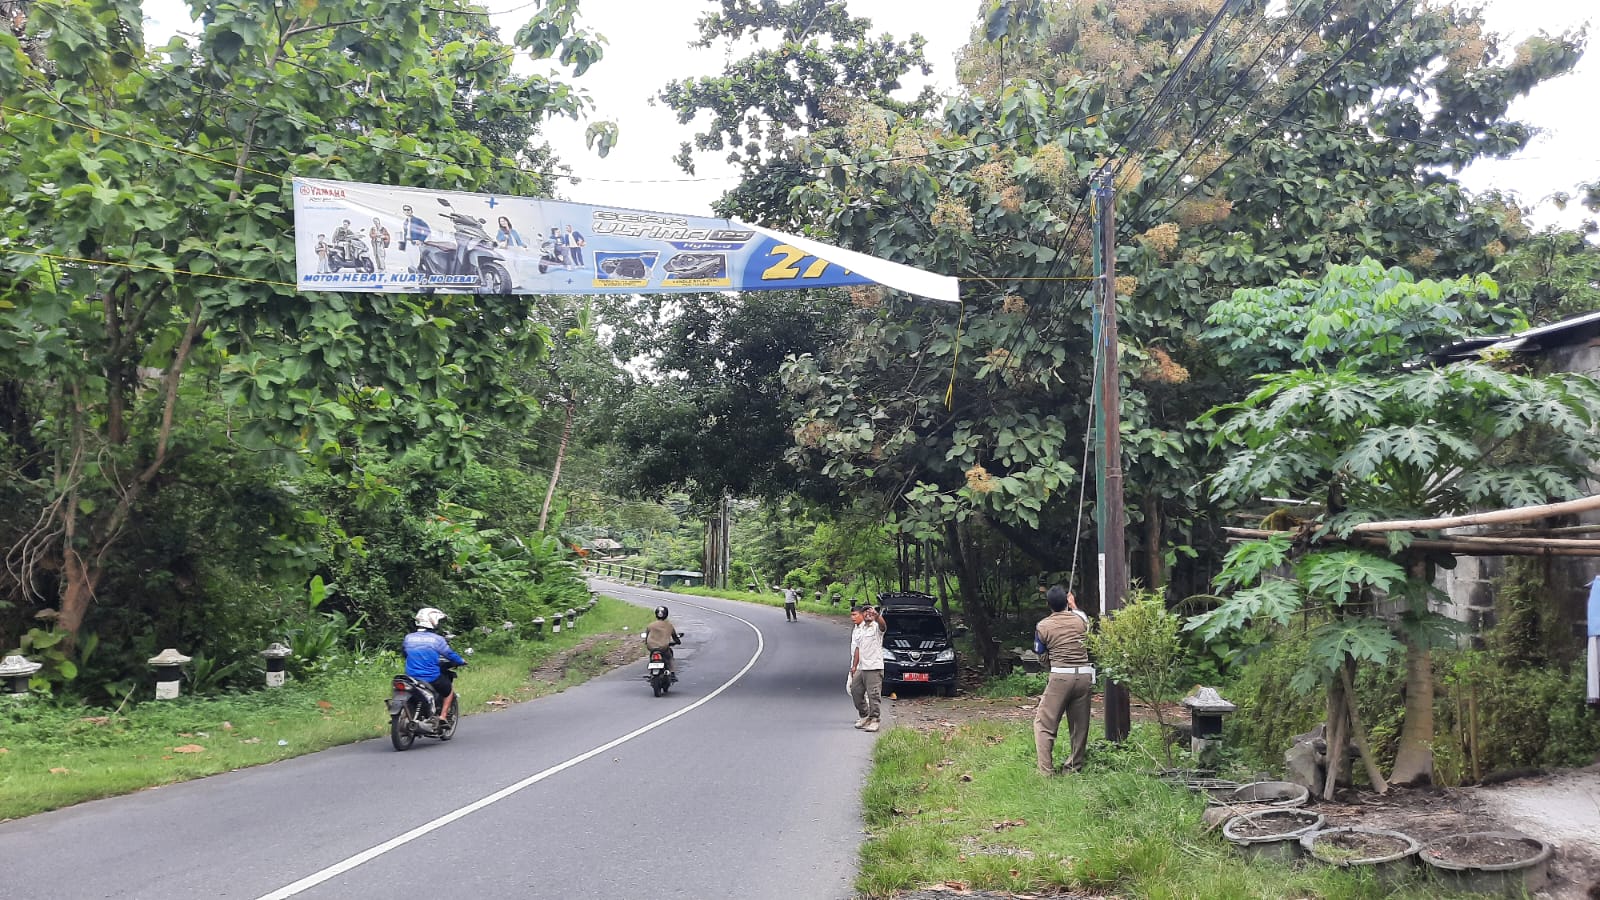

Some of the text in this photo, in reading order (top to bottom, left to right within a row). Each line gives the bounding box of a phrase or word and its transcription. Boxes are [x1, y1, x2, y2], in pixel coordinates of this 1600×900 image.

[310, 186, 346, 198] YAMAHA
[303, 274, 339, 282] MOTOR
[429, 275, 444, 283] NO
[444, 275, 479, 283] DEBAT
